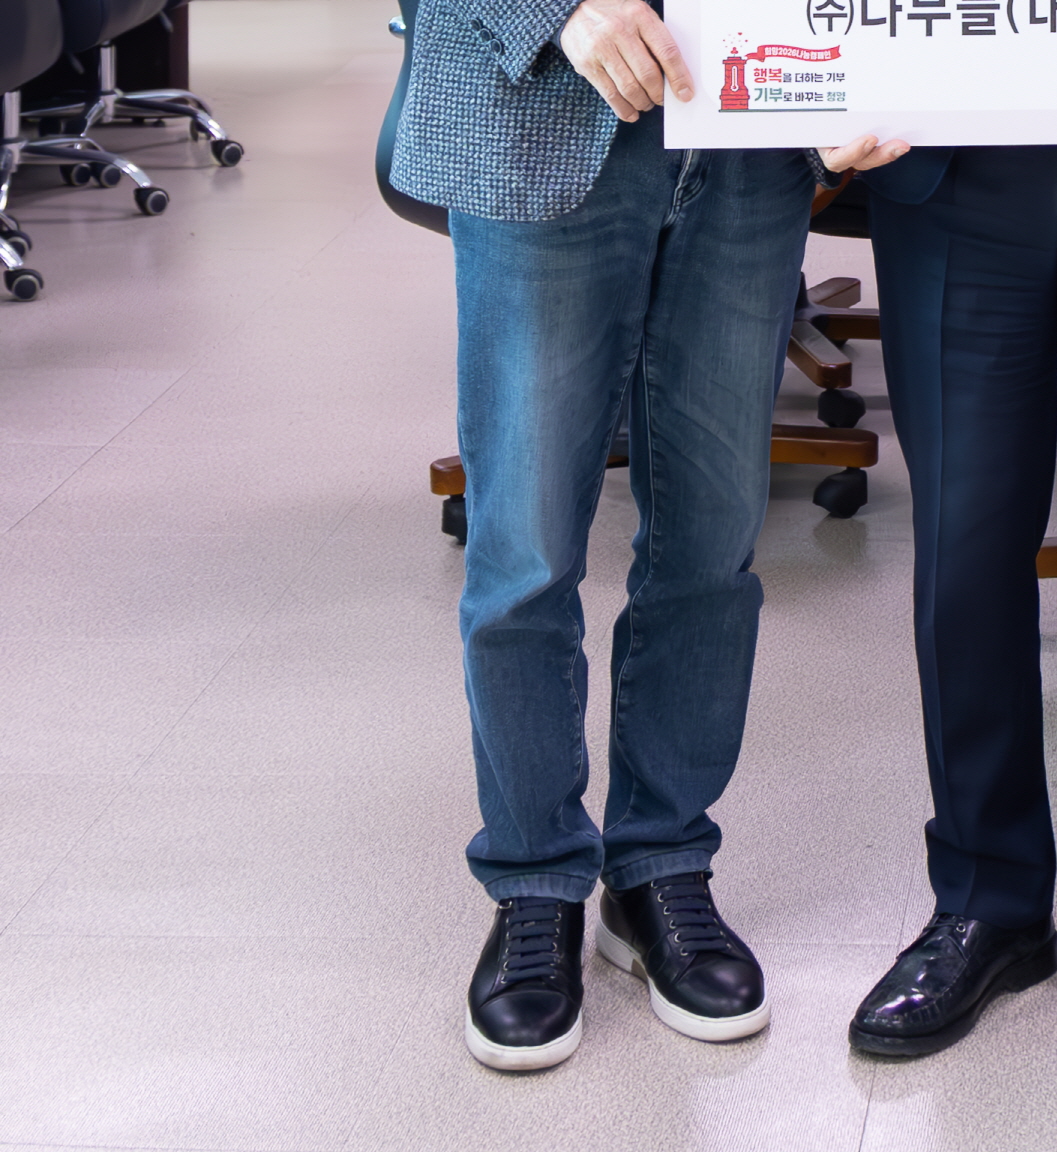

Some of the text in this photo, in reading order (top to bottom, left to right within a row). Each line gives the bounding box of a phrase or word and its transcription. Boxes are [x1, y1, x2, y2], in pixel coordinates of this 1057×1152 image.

[753, 67, 846, 83] 행복을 더하는 기부
[754, 87, 846, 103] 기부로 바꾸는 청양
